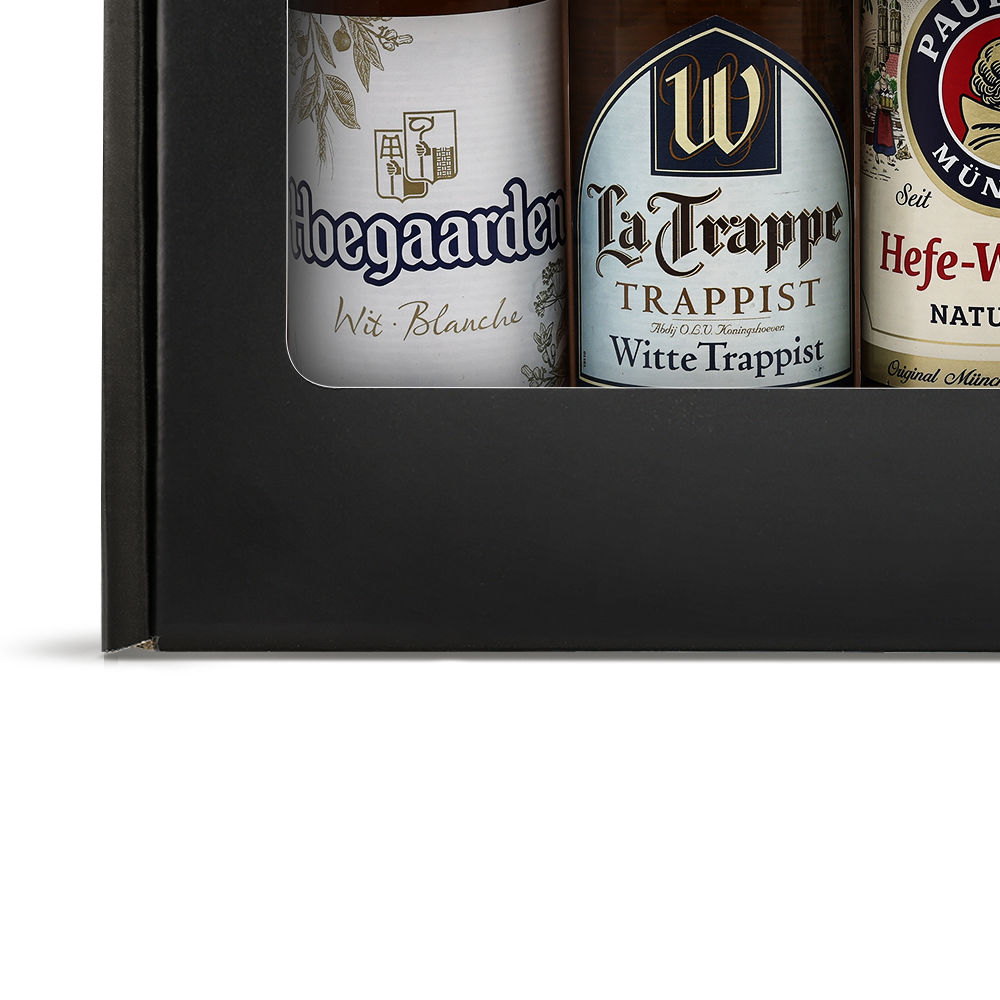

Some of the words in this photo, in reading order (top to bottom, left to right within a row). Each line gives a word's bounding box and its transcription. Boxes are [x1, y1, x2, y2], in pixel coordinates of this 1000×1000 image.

[895, 182, 932, 210] Seit
[288, 176, 567, 287] Hoegaarden
[586, 183, 652, 278] La
[647, 187, 844, 278] Trappe
[615, 277, 821, 316] TRAPPIST
[334, 296, 383, 337] Wit
[398, 297, 523, 342] Blanche
[715, 323, 785, 337] Koningshoeven
[609, 334, 697, 371] Witte
[697, 336, 824, 378] Trappist
[887, 359, 941, 384] Original
